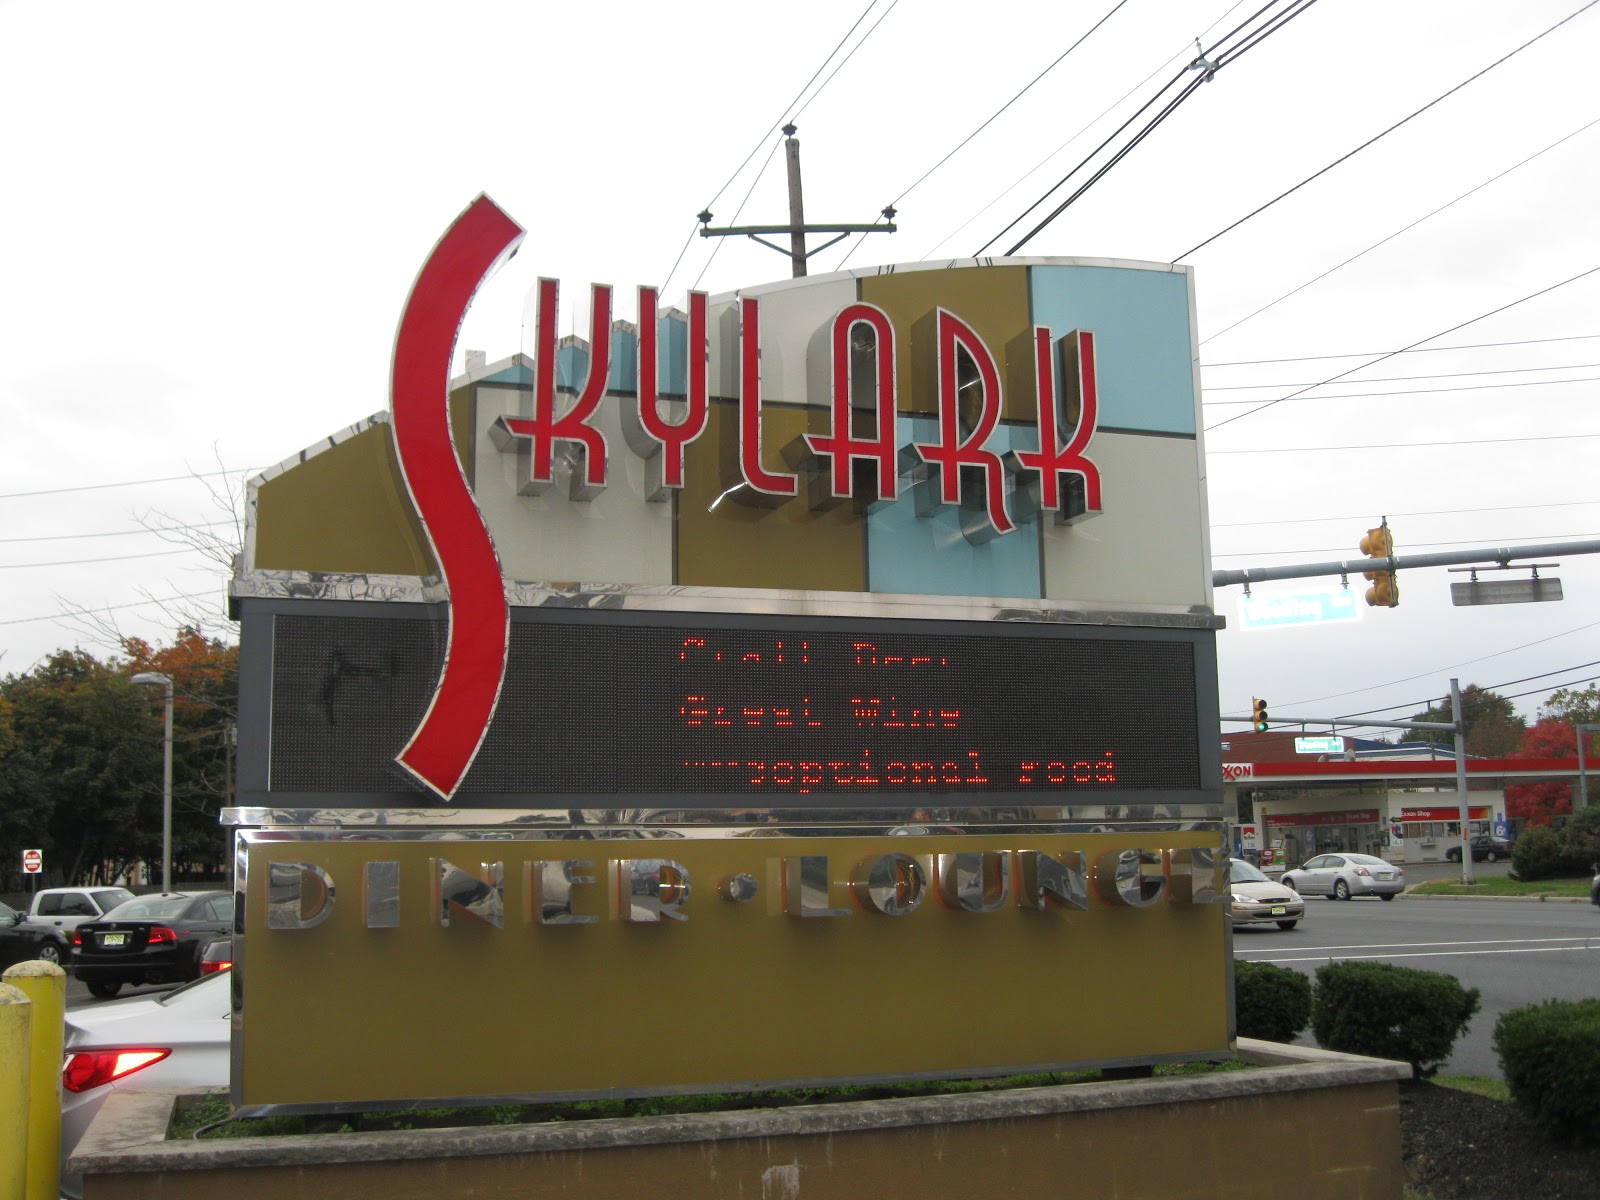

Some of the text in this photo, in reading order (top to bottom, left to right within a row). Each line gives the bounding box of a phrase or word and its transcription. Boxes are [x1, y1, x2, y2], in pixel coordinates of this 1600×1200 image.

[389, 190, 1104, 802] SKYLARK
[266, 848, 1235, 930] DINER LOUNGE
